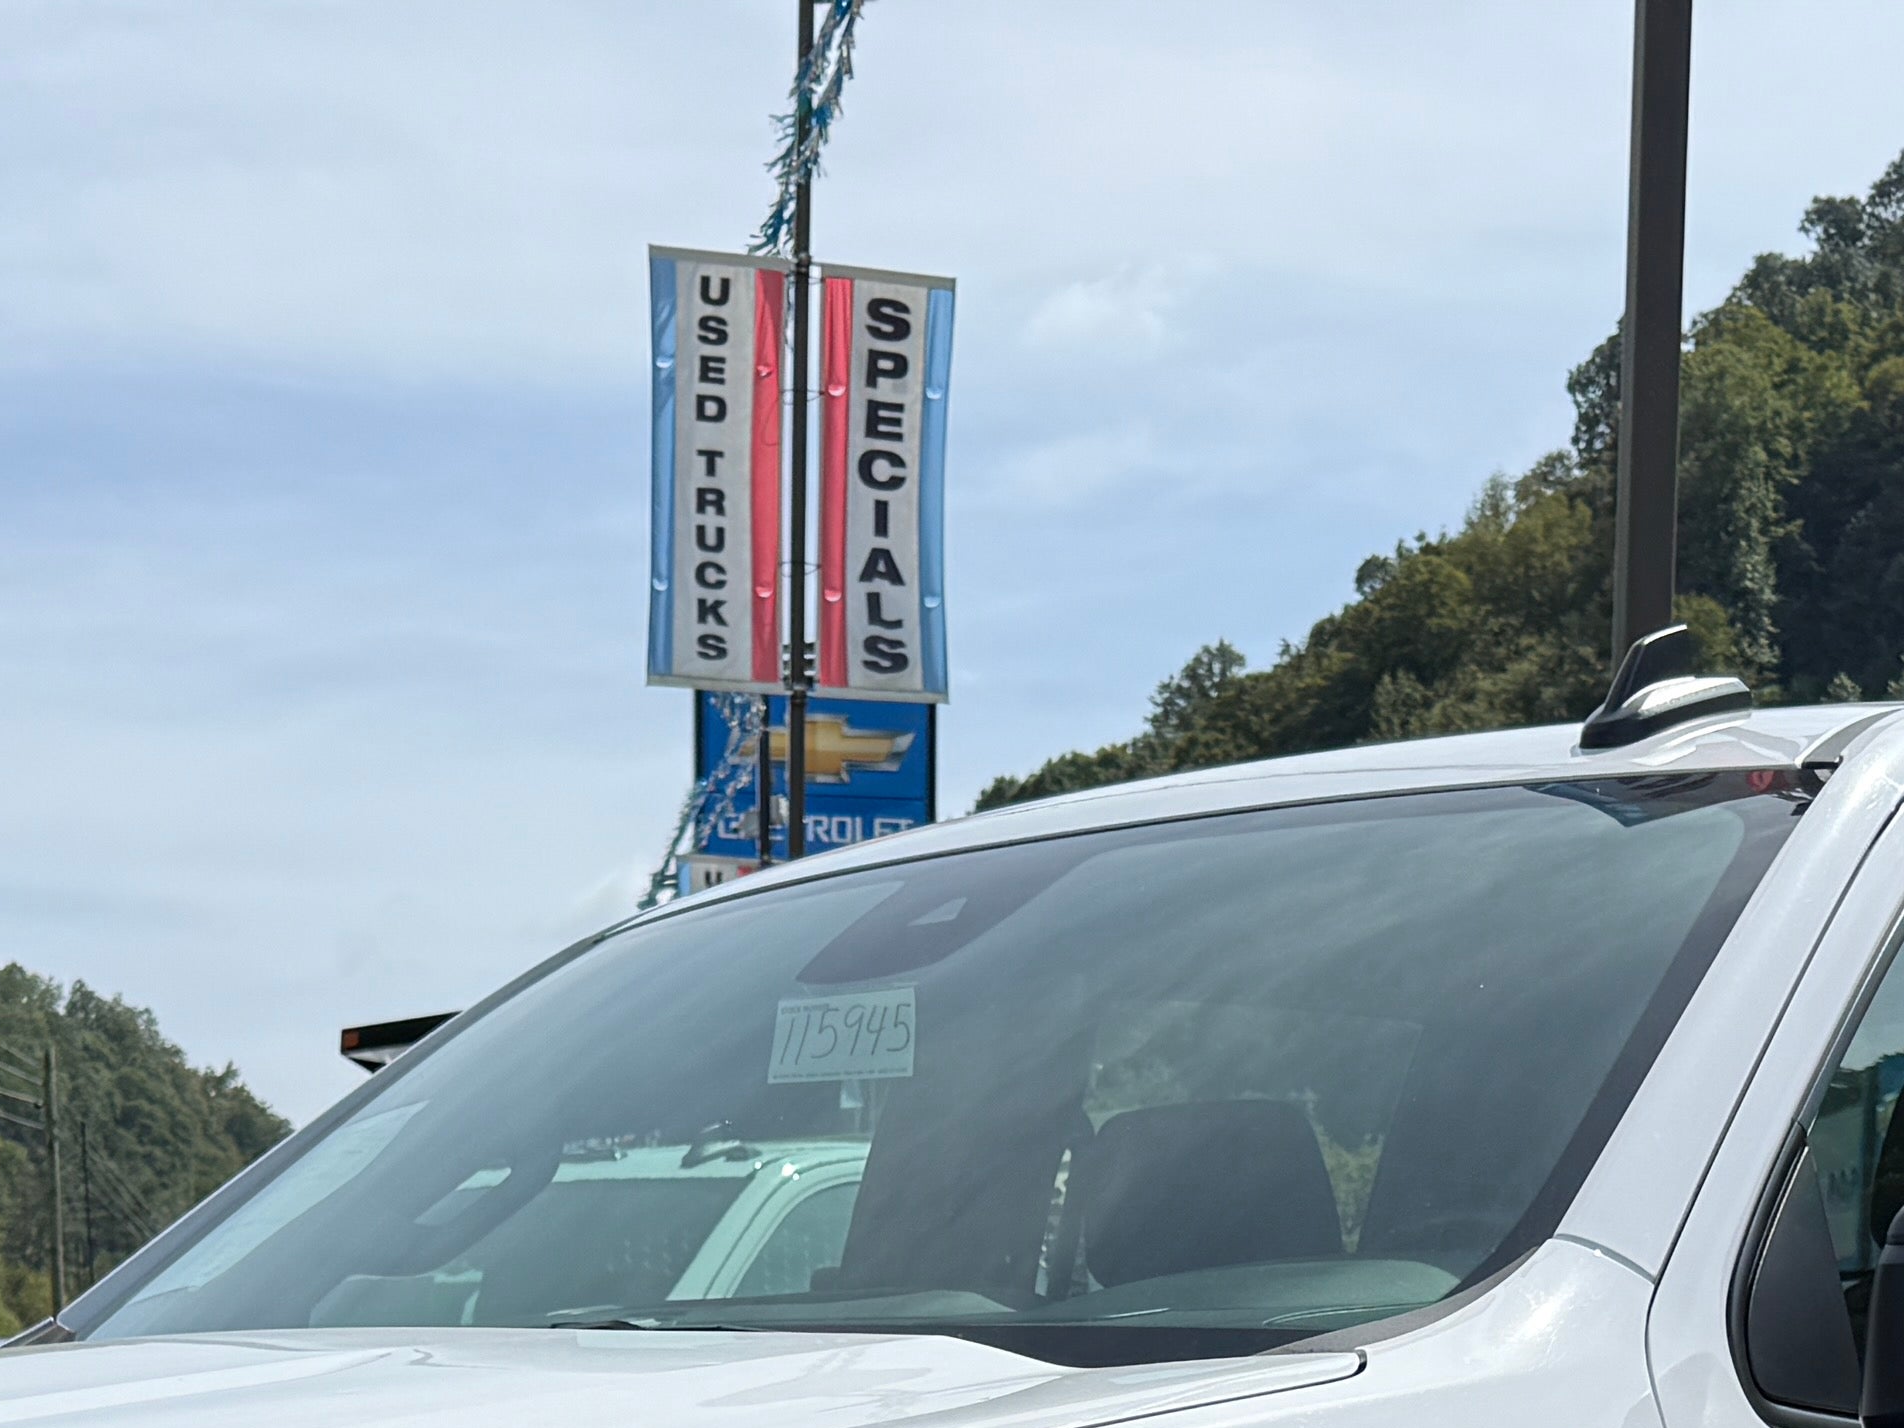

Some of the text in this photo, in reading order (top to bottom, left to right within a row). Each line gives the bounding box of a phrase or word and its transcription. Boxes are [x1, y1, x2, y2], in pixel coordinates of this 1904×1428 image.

[694, 275, 731, 661] USED TRUCKS
[856, 297, 912, 675] SPECIALS
[779, 1003, 911, 1066] 115945
